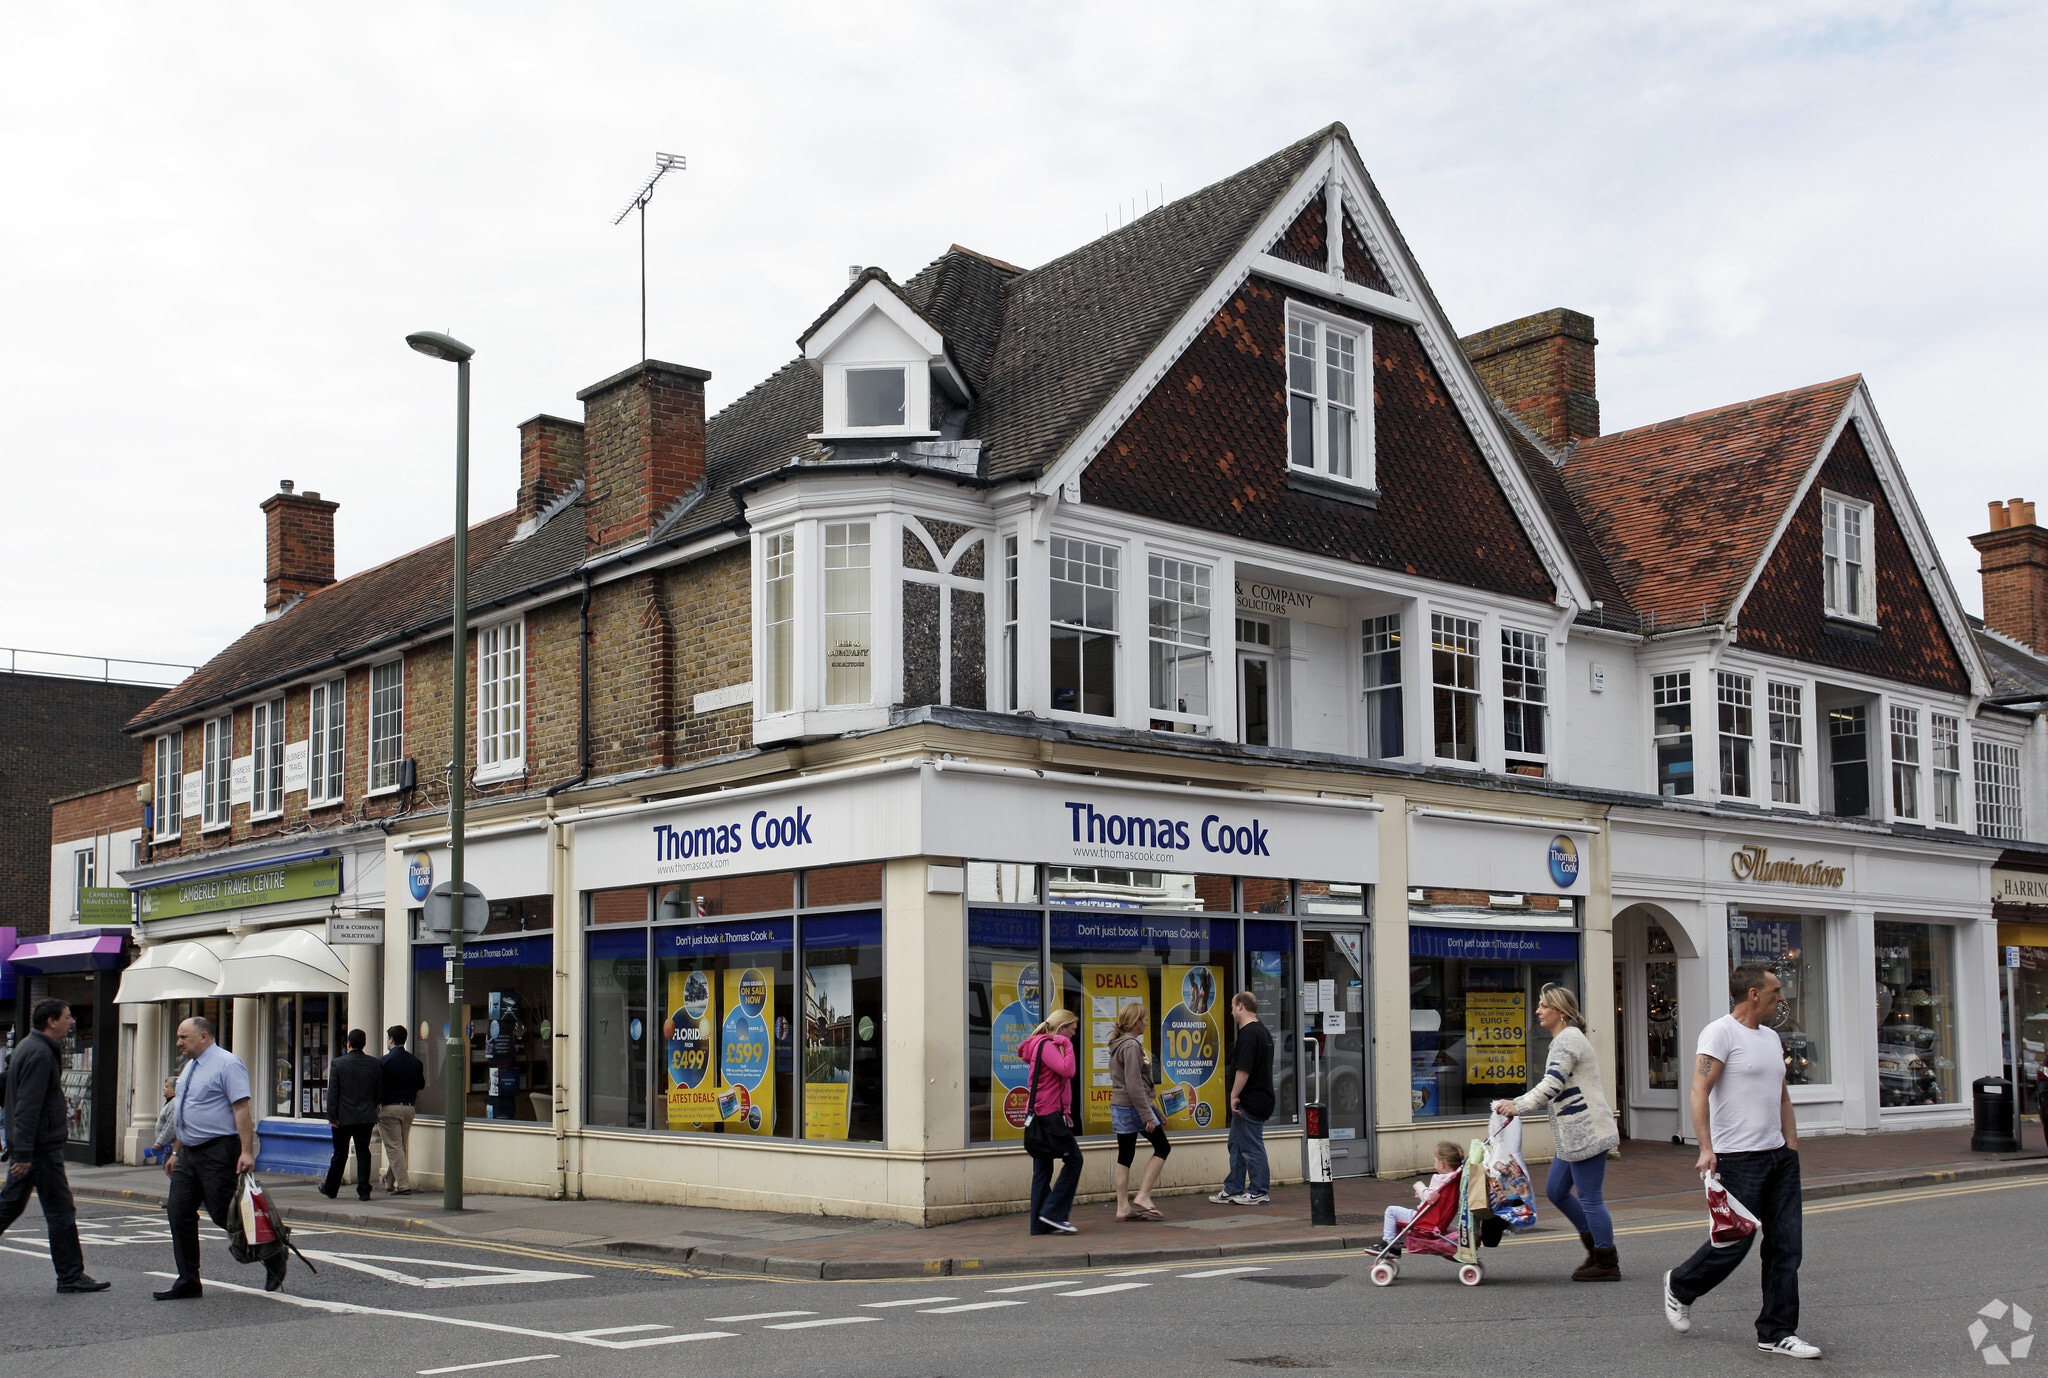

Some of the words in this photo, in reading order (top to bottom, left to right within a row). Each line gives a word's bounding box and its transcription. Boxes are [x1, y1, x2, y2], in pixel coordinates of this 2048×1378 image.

[1251, 584, 1314, 608] COMPANY
[1236, 596, 1287, 614] SOLICITORS
[826, 648, 869, 657] COMPANY
[285, 750, 307, 762] BUSINESS
[232, 764, 251, 776] BUSINESS
[288, 762, 304, 772] TRAVEL
[184, 779, 201, 791] BUSINESS
[235, 776, 248, 785] TRAVEL
[187, 790, 199, 799] TRAVEL
[653, 823, 743, 862] Thomas
[750, 805, 813, 850] Cook
[1065, 801, 1190, 851] Thomas
[1201, 814, 1271, 857] Cook
[1073, 846, 1175, 863] www.thomascook.com
[1551, 849, 1577, 862] Thomas
[410, 866, 430, 876] Thomas
[657, 858, 730, 874] www.thomascook.com
[1561, 862, 1577, 873] Cook
[1731, 844, 1846, 888] Illuminations
[417, 875, 431, 886] Cook
[179, 881, 222, 904] CAMBERLEY
[224, 875, 252, 898] TRAVEL
[253, 870, 286, 892] CENTRE
[1078, 924, 1100, 936] Don't
[1101, 925, 1117, 938] just
[1118, 926, 1138, 937] book
[1148, 927, 1179, 939] Thomas
[1179, 928, 1201, 939] Cook
[676, 936, 691, 946] Don't
[691, 935, 703, 947] just
[703, 933, 719, 944] book
[725, 932, 749, 942] Thomas
[750, 931, 767, 941] Cook
[1448, 938, 1463, 947] Don't
[1464, 938, 1475, 950] just
[1476, 938, 1491, 948] book
[1497, 939, 1519, 949] Thomas
[1520, 940, 1534, 949] Cook
[469, 950, 480, 959] book
[484, 949, 502, 958] Thomas
[502, 948, 514, 957] Cook
[1095, 973, 1139, 989] DEALS
[741, 987, 751, 996] ON
[751, 986, 766, 995] SALE
[745, 996, 761, 1005] NOW
[1005, 1023, 1026, 1033] NEW
[1469, 1026, 1523, 1041] 1.1369
[1000, 1034, 1019, 1043] P&O
[1166, 1030, 1212, 1059] 10%
[1472, 1065, 1526, 1080] 1.4848
[669, 1093, 692, 1104] LATEST
[693, 1092, 715, 1103] DEALS
[1010, 1093, 1018, 1107] 3
[1091, 1090, 1112, 1101] LATE
[1197, 1107, 1210, 1117] 0%
